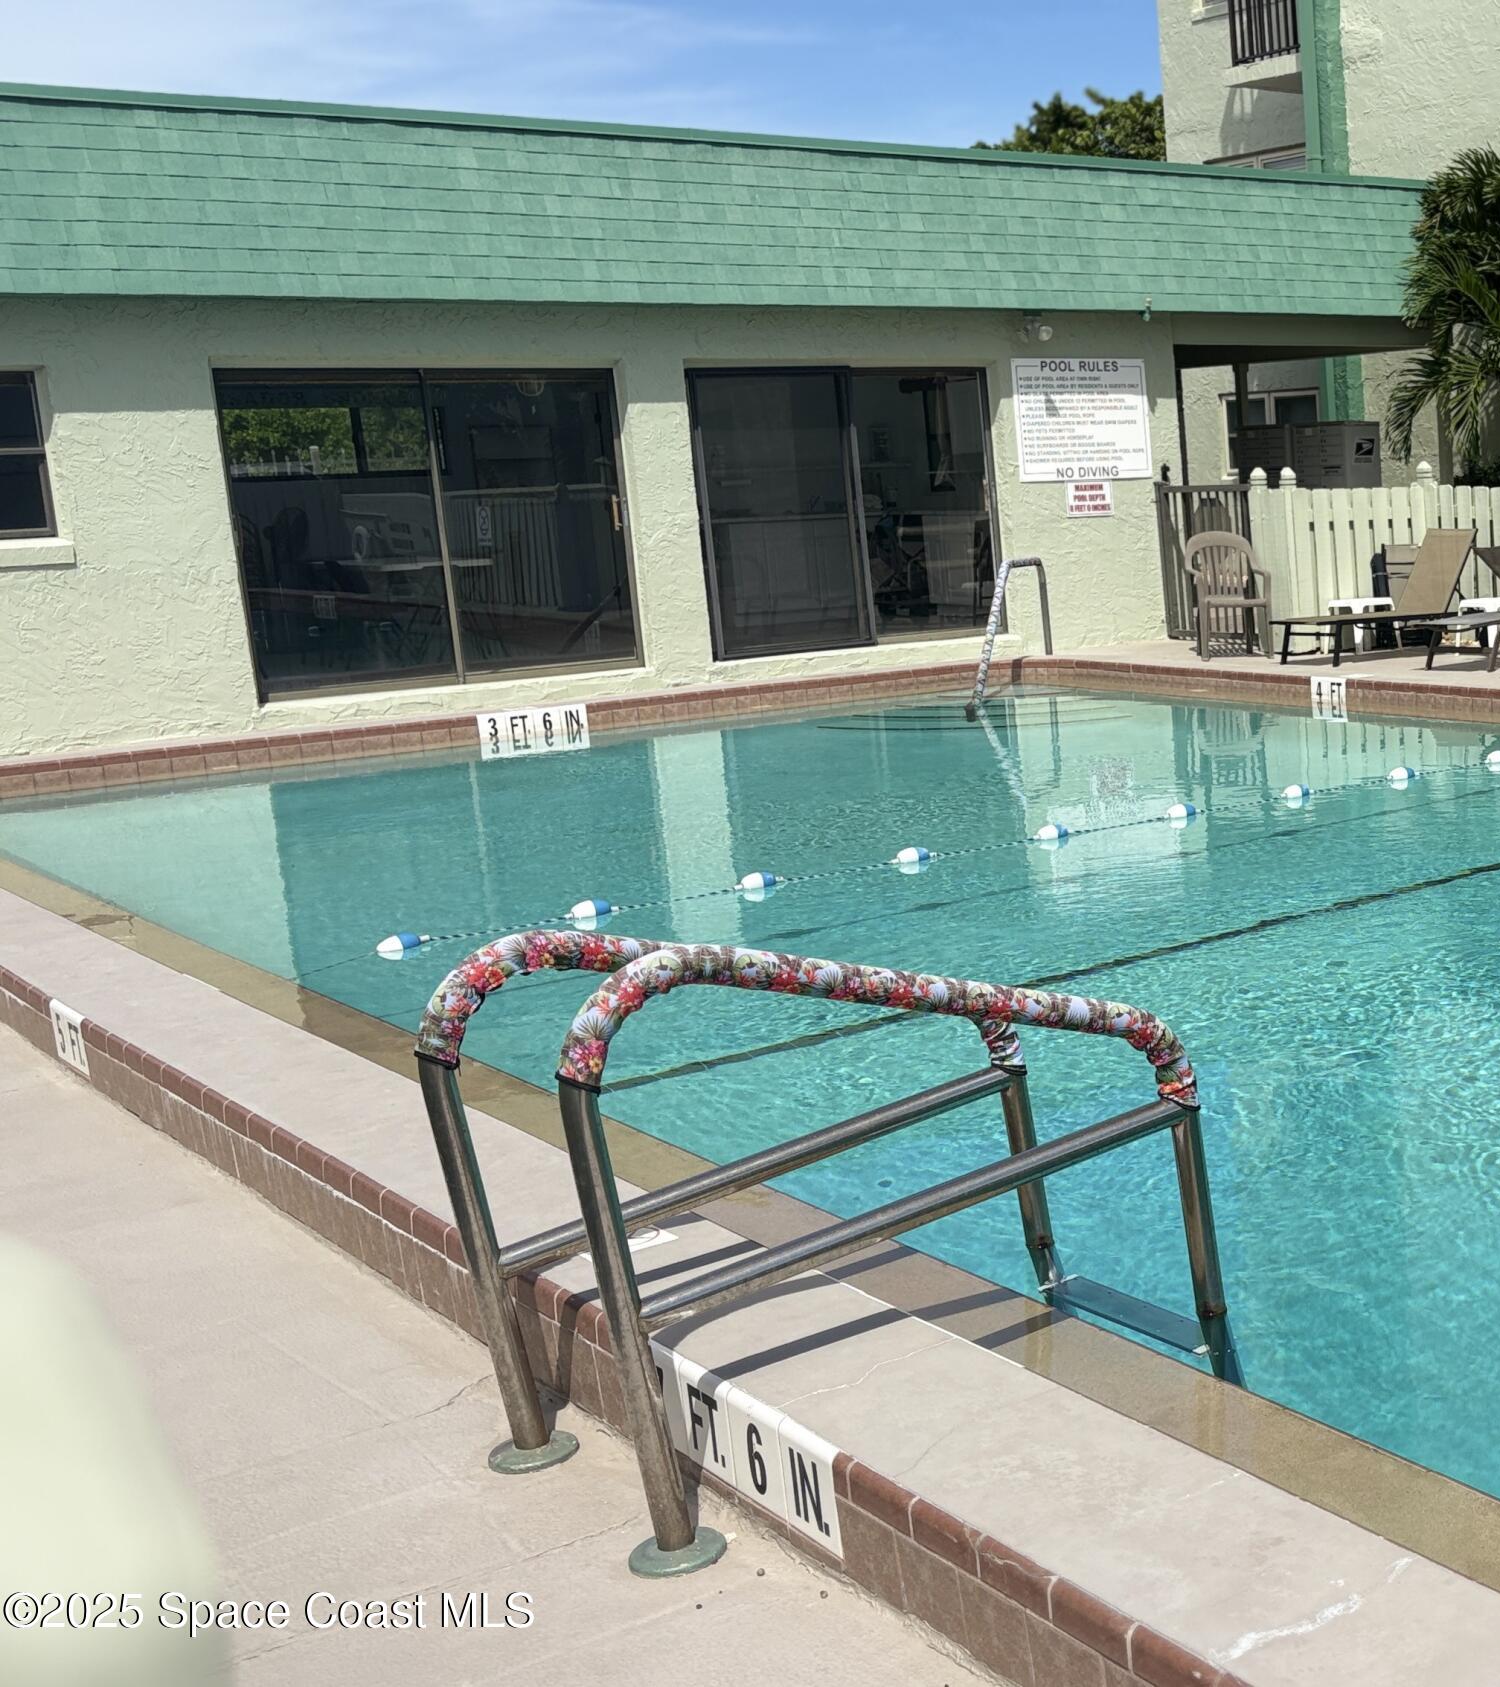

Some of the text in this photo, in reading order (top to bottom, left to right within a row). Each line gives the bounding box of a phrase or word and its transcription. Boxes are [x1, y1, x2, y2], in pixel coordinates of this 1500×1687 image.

[1040, 361, 1119, 372] POOL RULES
[1057, 466, 1119, 478] NO DIVING
[1074, 484, 1103, 492] MAXIMUM
[1073, 493, 1106, 502] POOL DEPTH
[1075, 504, 1086, 512] FEET
[1316, 682, 1323, 699] 4
[487, 709, 584, 737] 3 FT. 6 IN.
[55, 1012, 86, 1067] 5 FT.
[687, 1383, 831, 1538] FT. 6 IN.
